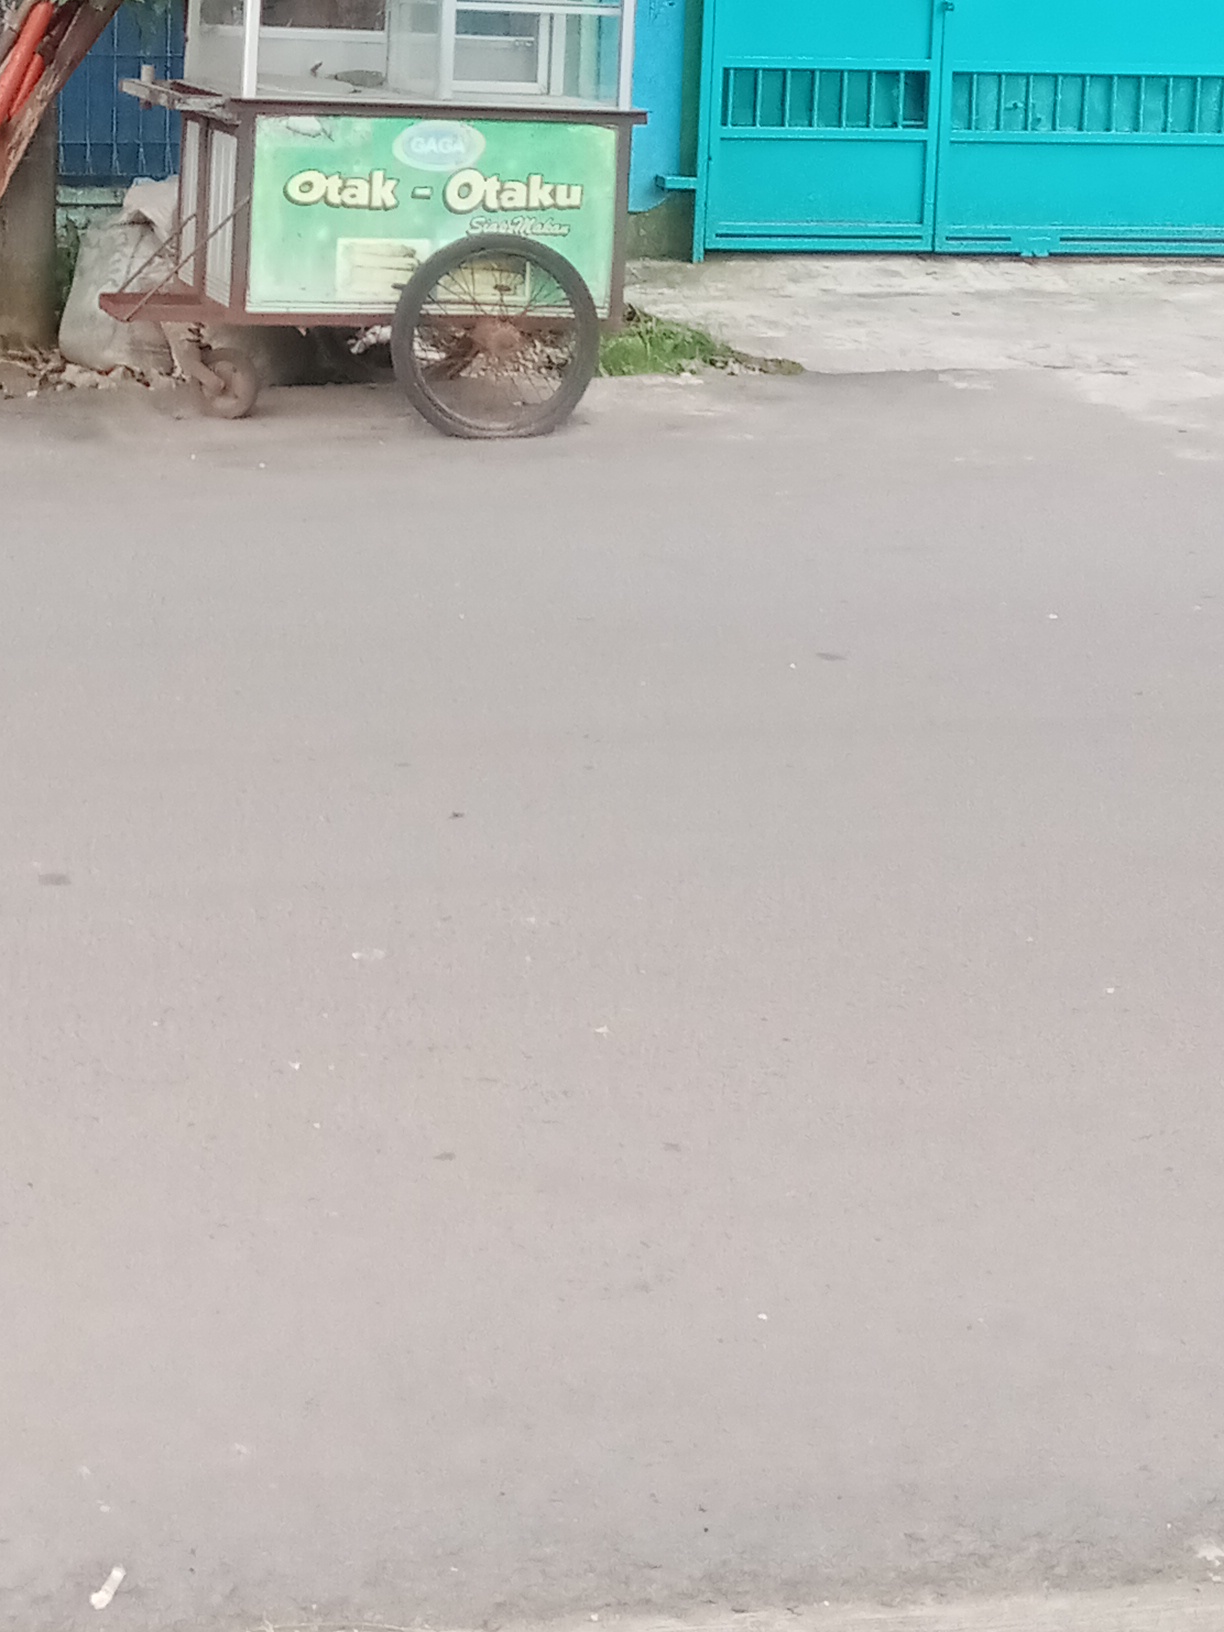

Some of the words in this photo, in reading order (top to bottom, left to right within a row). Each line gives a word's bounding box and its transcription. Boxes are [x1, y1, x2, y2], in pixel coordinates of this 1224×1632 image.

[409, 135, 466, 155] GAGA
[283, 168, 400, 211] Otak
[443, 166, 585, 215] Otaku
